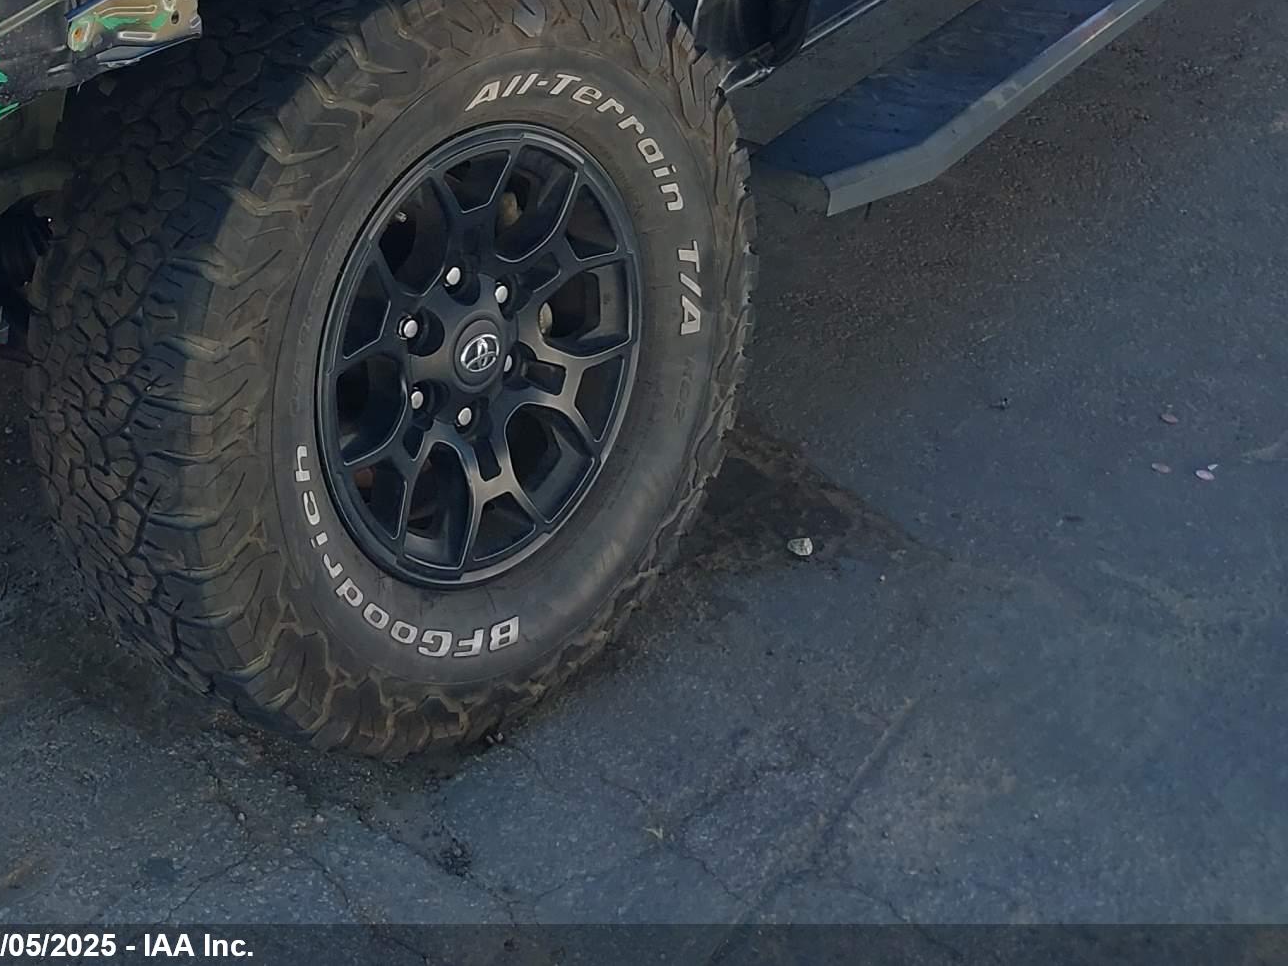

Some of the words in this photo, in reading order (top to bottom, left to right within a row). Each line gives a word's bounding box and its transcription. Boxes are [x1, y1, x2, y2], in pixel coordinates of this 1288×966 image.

[465, 73, 684, 211] All-Terrain
[678, 240, 702, 335] T/A
[295, 445, 519, 657] BFGoodrich
